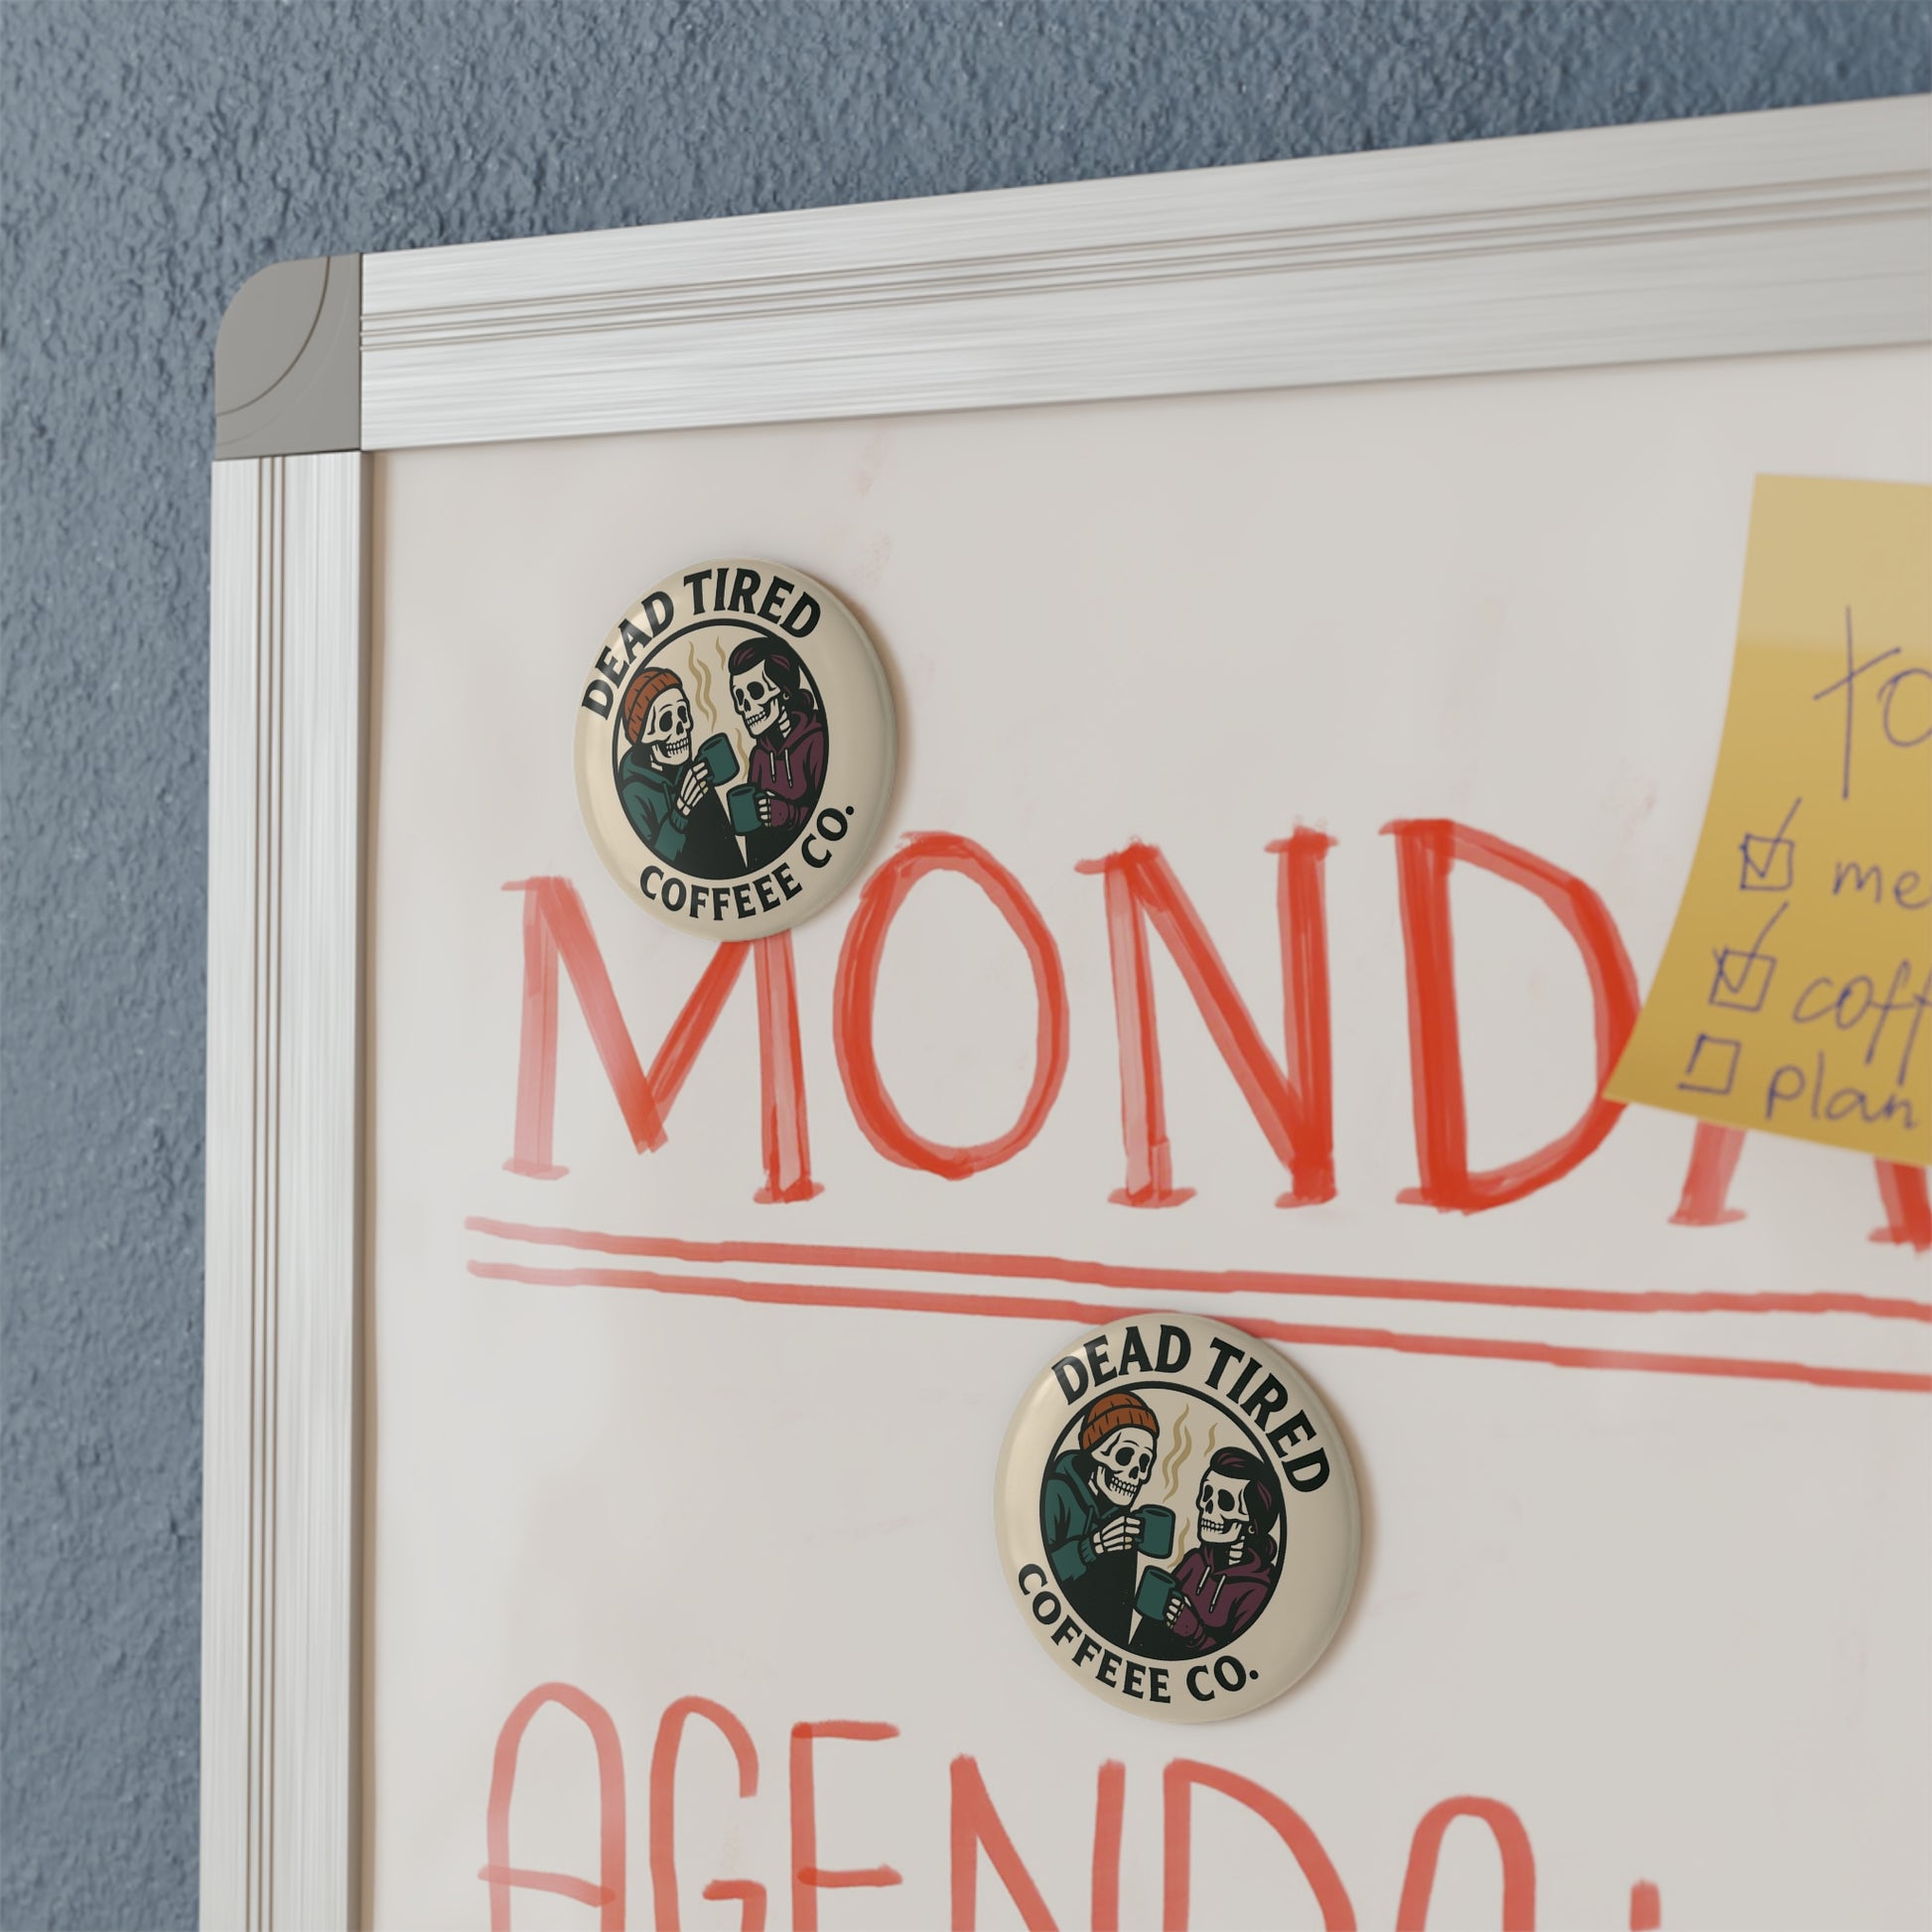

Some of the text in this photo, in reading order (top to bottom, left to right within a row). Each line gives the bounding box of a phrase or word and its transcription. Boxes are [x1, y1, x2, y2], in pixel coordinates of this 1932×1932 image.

[581, 568, 821, 721] DEAD TIRED
[639, 805, 855, 921] COFFEEE CO.
[1763, 1048, 1917, 1131] plan
[1051, 1324, 1330, 1493] DEAD TIRED
[1018, 1563, 1259, 1704] COFFEEE CO.
